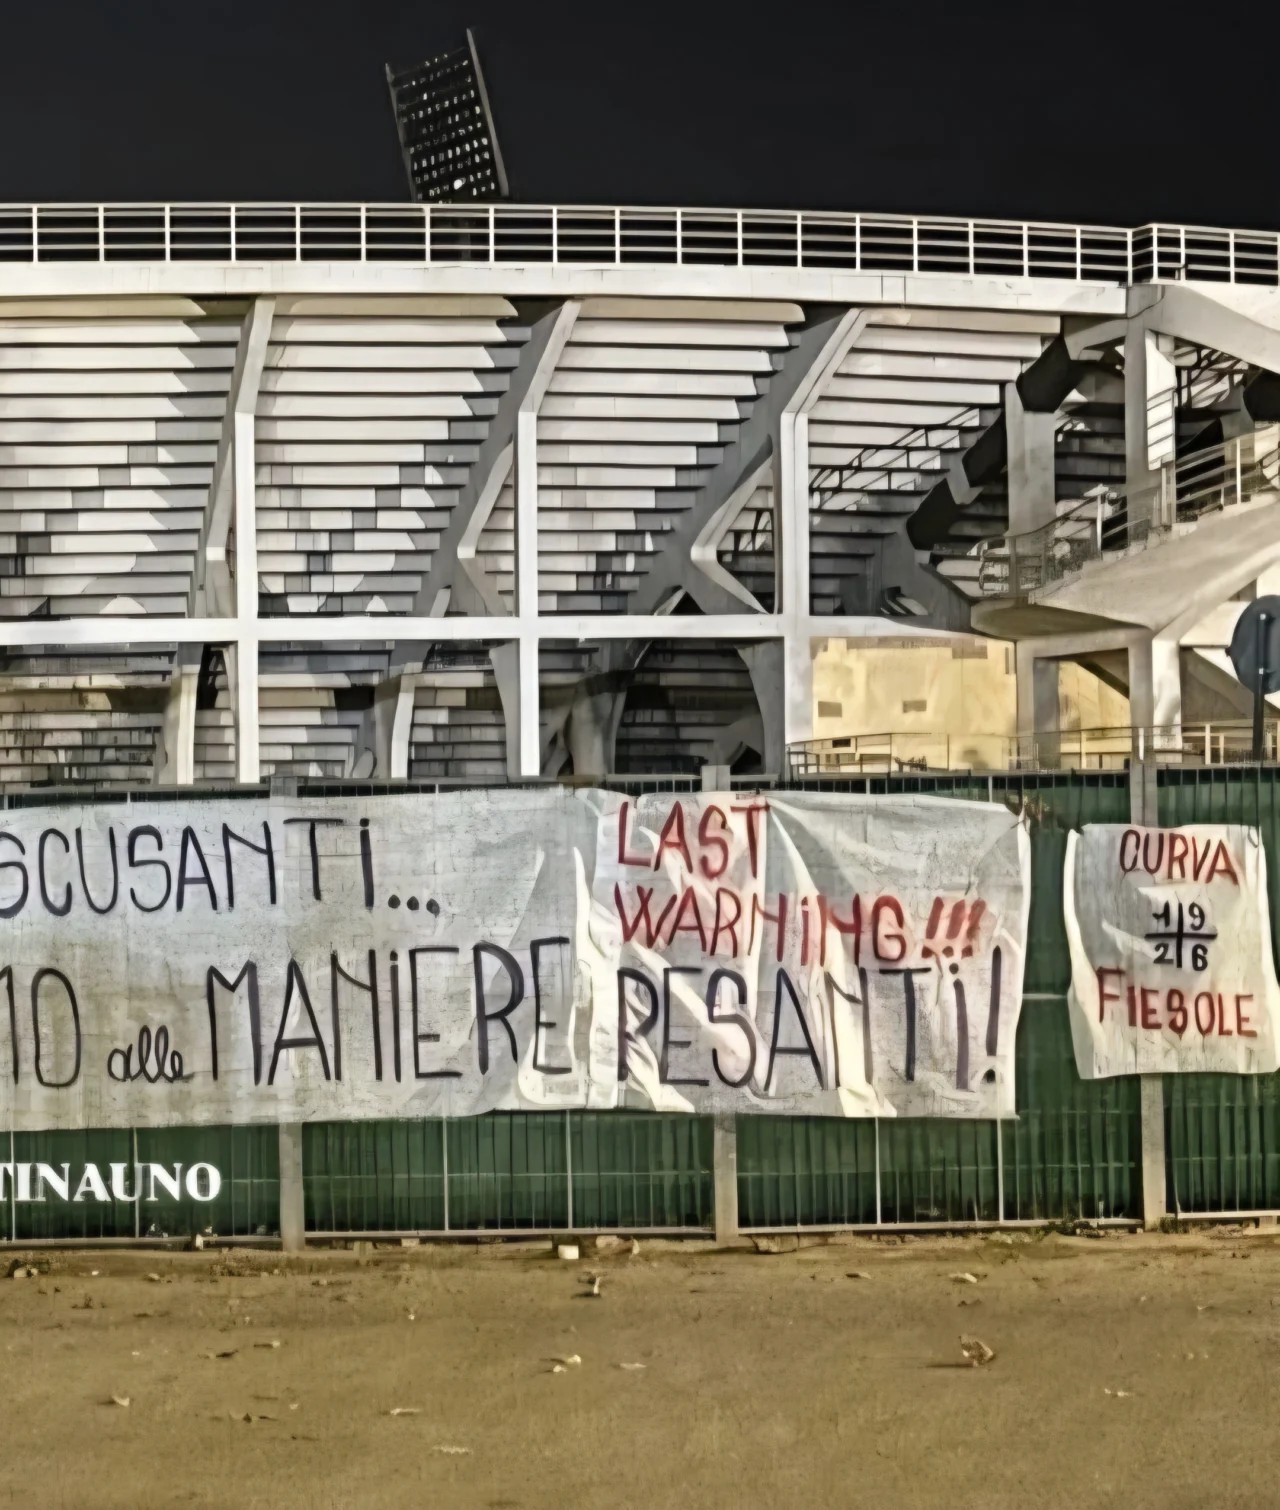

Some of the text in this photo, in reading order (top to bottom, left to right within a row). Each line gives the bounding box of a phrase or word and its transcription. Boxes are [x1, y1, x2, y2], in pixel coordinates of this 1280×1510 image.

[617, 801, 772, 880] LAST
[1120, 829, 1239, 886] CURVA
[1096, 966, 1258, 1040] FIESOLE
[107, 1024, 195, 1085] alle
